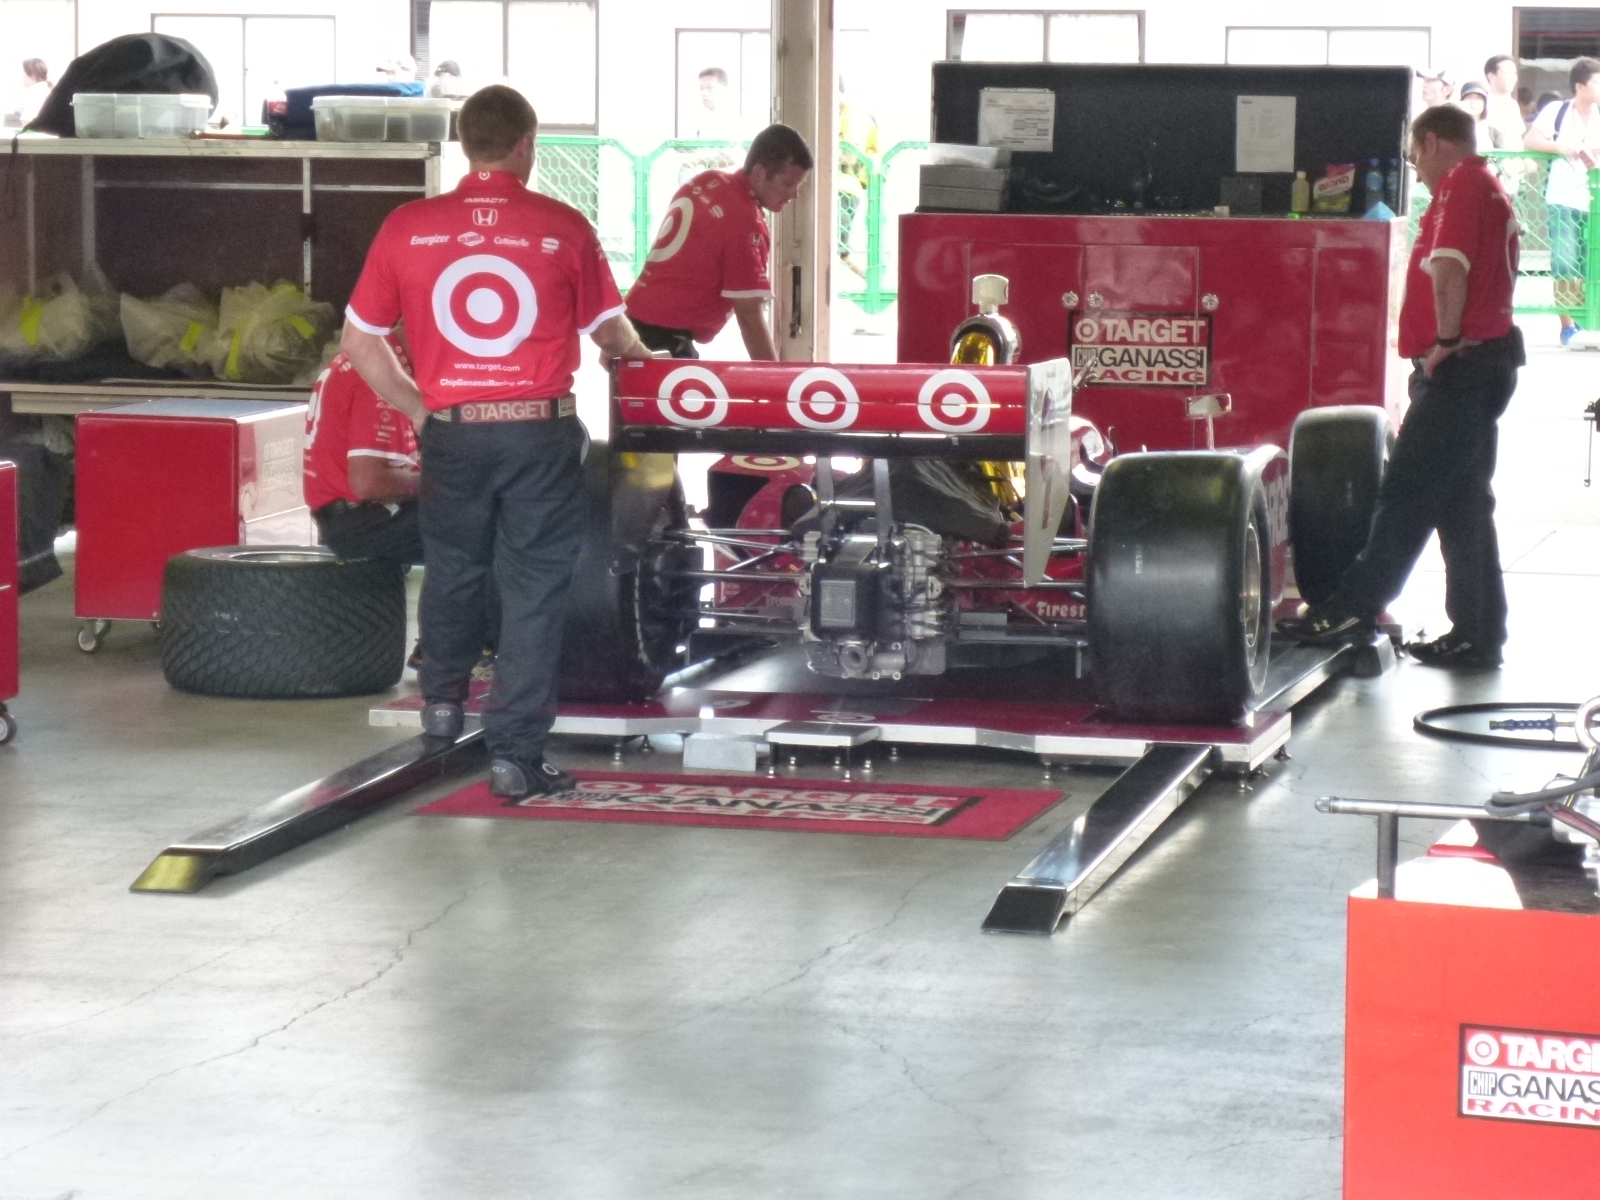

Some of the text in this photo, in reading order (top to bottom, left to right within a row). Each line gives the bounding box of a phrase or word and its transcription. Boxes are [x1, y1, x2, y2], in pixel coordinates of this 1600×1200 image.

[410, 234, 450, 246] Energizer
[493, 236, 530, 247] Cottonelle
[1101, 318, 1206, 343] TARGET
[454, 362, 521, 372] www.target.com
[1098, 347, 1204, 369] GANASSI
[476, 401, 549, 421] TARGET
[654, 783, 958, 807] TARGET
[1469, 1070, 1497, 1097] CHIP
